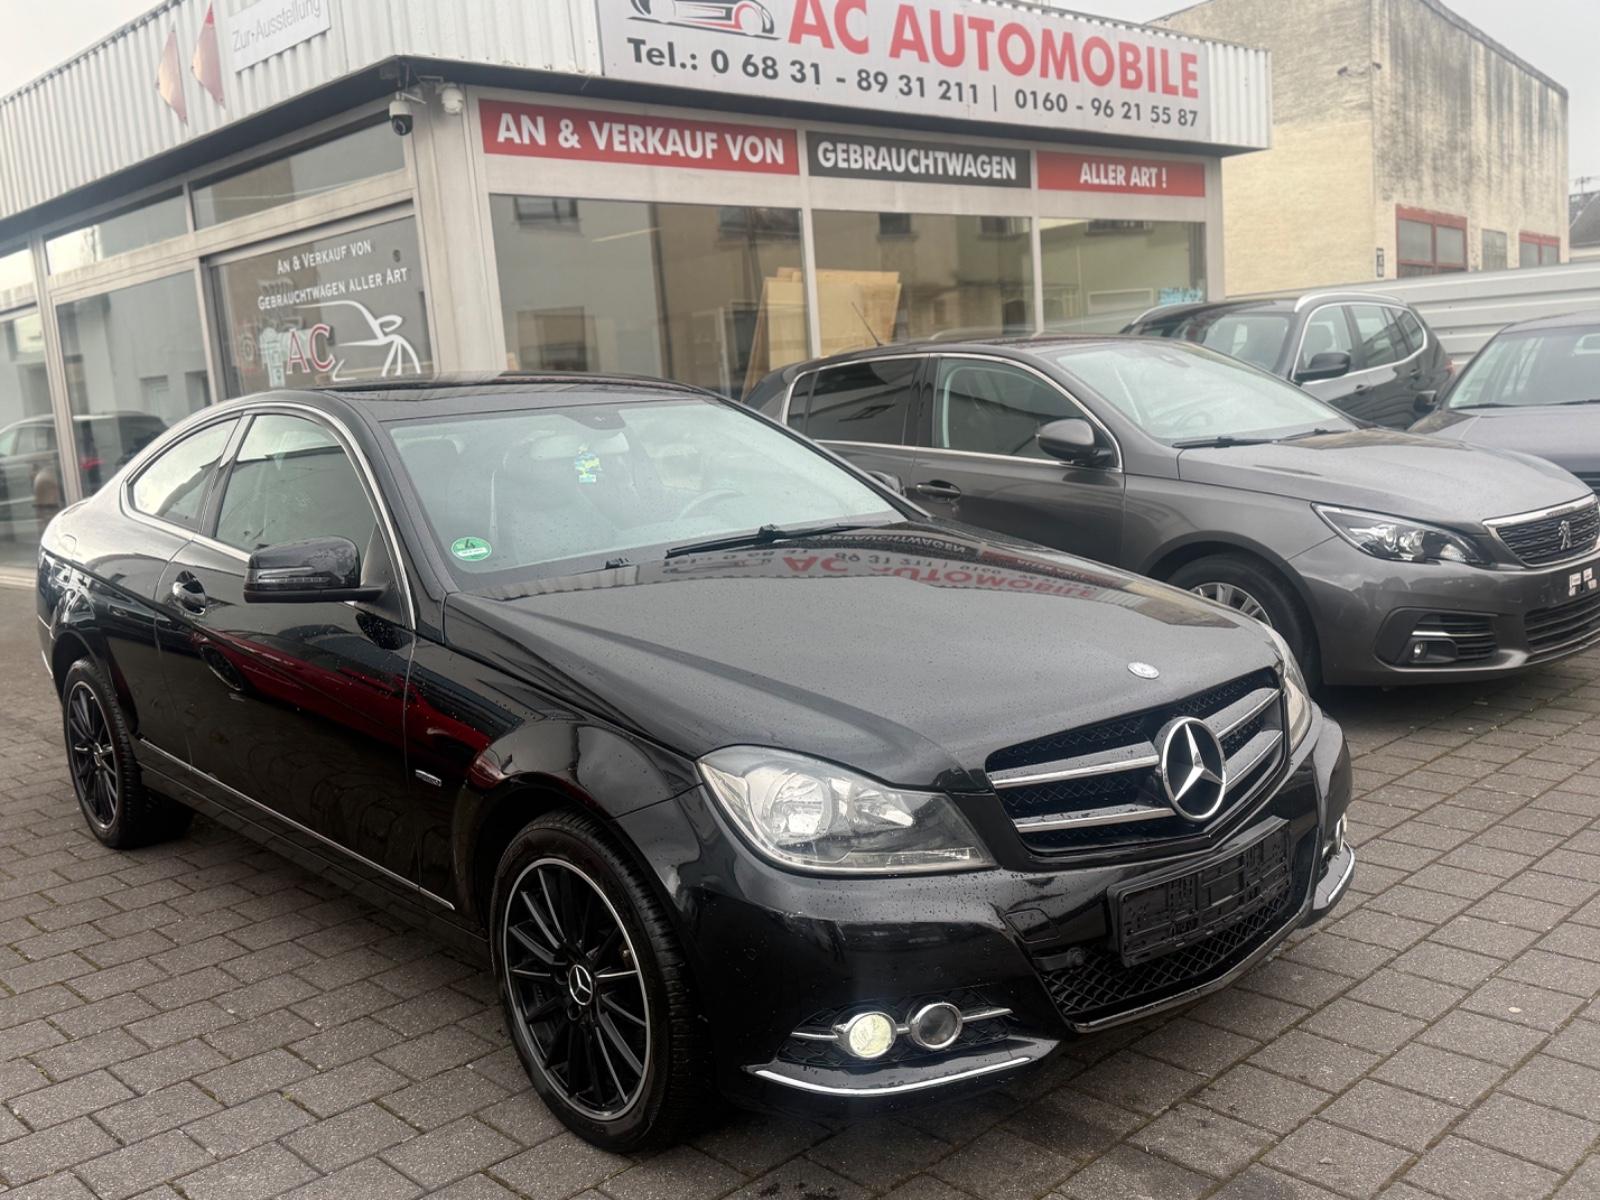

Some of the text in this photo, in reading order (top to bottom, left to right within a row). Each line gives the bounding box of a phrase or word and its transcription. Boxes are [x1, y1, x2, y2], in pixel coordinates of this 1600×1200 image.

[788, 0, 1199, 99] AC AUTOMOBILE
[627, 37, 698, 71] Tel.:
[711, 49, 729, 74] 0
[741, 54, 779, 80] 68
[789, 60, 821, 85] 31
[856, 69, 888, 92] 89
[898, 75, 925, 97] 31
[938, 79, 978, 104] 211
[1014, 89, 1068, 113] 0160
[1091, 98, 1114, 118] 96
[1121, 102, 1142, 121] 21
[1150, 105, 1171, 125] 55
[1178, 108, 1198, 127] 87
[497, 113, 784, 164] AN & VERKAUF VON
[817, 141, 1017, 180] GEBRAUCHTWAGEN
[1080, 162, 1126, 187] ALLER
[1129, 165, 1158, 188] ART
[293, 255, 301, 270] &
[286, 323, 336, 375] AC
